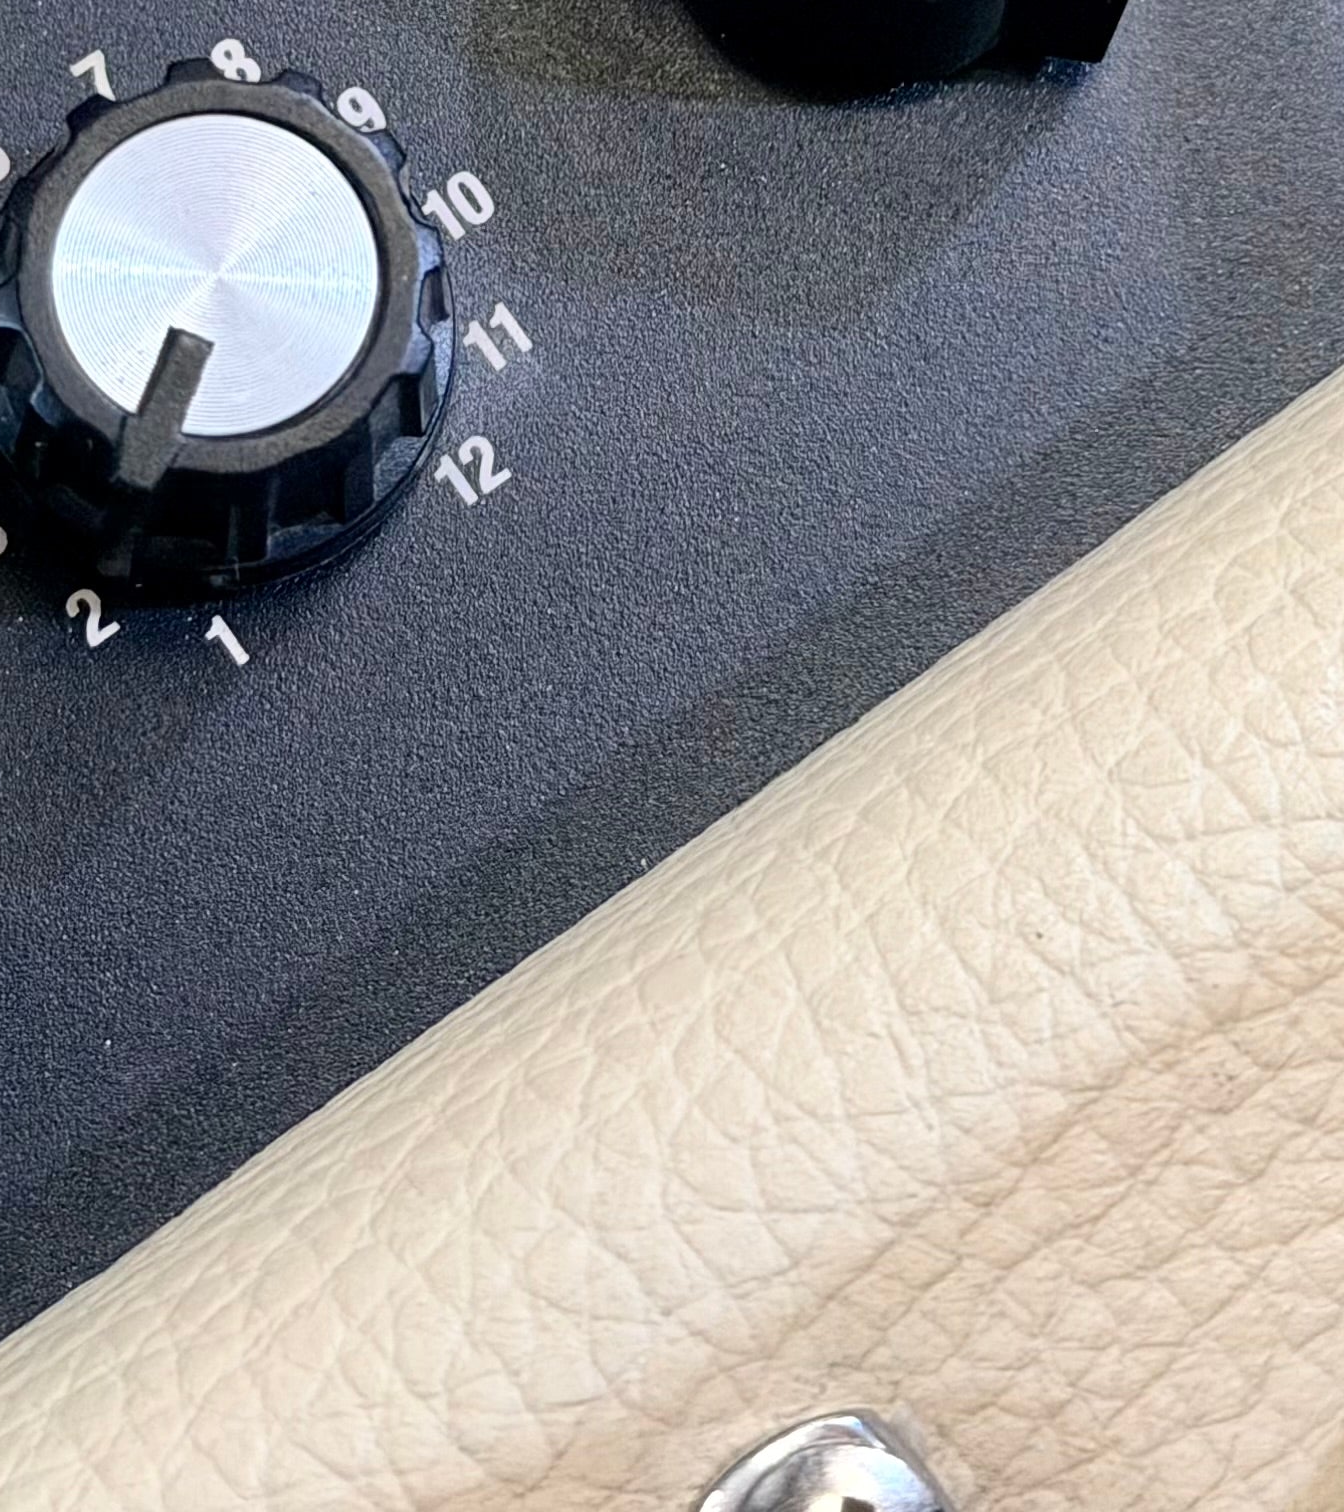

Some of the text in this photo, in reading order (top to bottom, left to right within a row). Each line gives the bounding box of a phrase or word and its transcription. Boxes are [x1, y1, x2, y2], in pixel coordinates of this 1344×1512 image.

[69, 48, 116, 102] 7
[210, 37, 262, 85] 8
[336, 86, 387, 133] 9
[422, 170, 496, 240] 10
[462, 302, 536, 371] 11
[432, 434, 513, 507] 12
[64, 588, 121, 648] 2
[204, 615, 251, 667] 1
